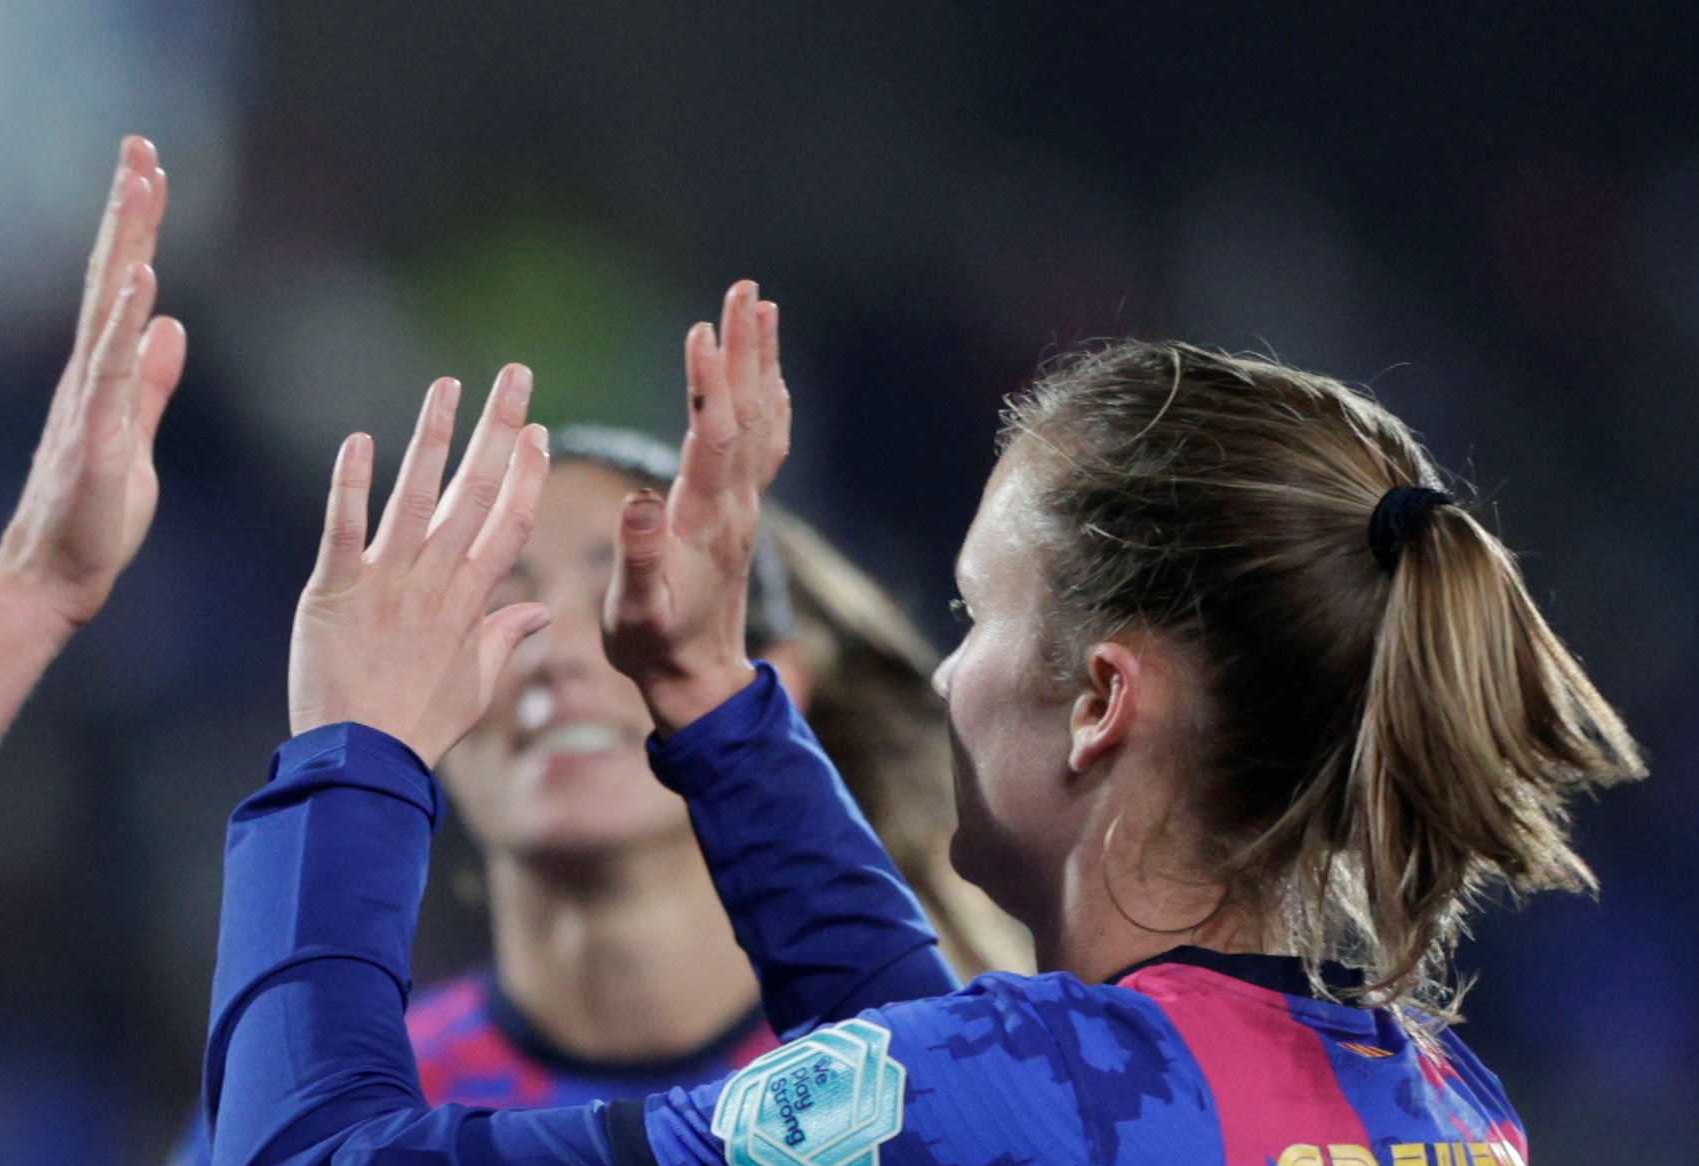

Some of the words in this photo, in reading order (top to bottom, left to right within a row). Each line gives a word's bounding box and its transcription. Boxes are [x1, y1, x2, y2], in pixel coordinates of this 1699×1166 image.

[790, 1066, 816, 1114] play
[812, 1054, 832, 1086] We
[770, 1077, 807, 1147] Strong
